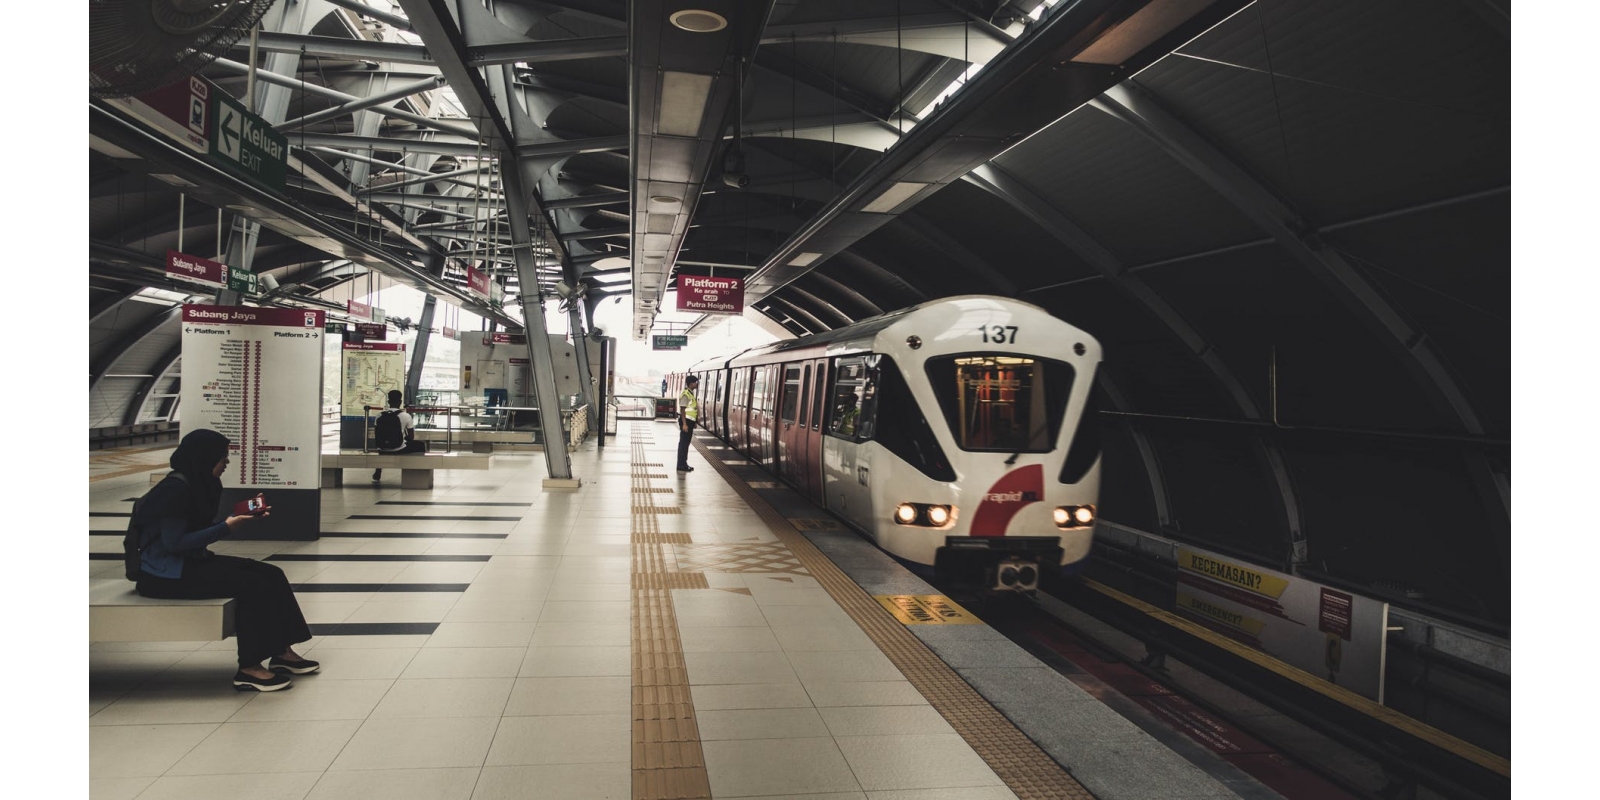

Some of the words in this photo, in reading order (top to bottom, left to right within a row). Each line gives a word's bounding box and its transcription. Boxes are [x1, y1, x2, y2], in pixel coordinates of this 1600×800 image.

[192, 79, 206, 97] KJ28
[242, 117, 283, 160] Keluar
[241, 148, 262, 174] EXIT
[172, 257, 193, 272] Subang
[194, 263, 206, 275] Jaya
[231, 269, 248, 281] Keluar
[685, 278, 729, 289] Platform
[731, 281, 738, 289] 2
[707, 301, 735, 310] Heights
[189, 310, 229, 321] Subang
[231, 311, 256, 322] Jaya
[978, 325, 1019, 344] 137
[1191, 555, 1262, 589] KECEMASAN?
[1191, 599, 1243, 626] EMERGENCY?
